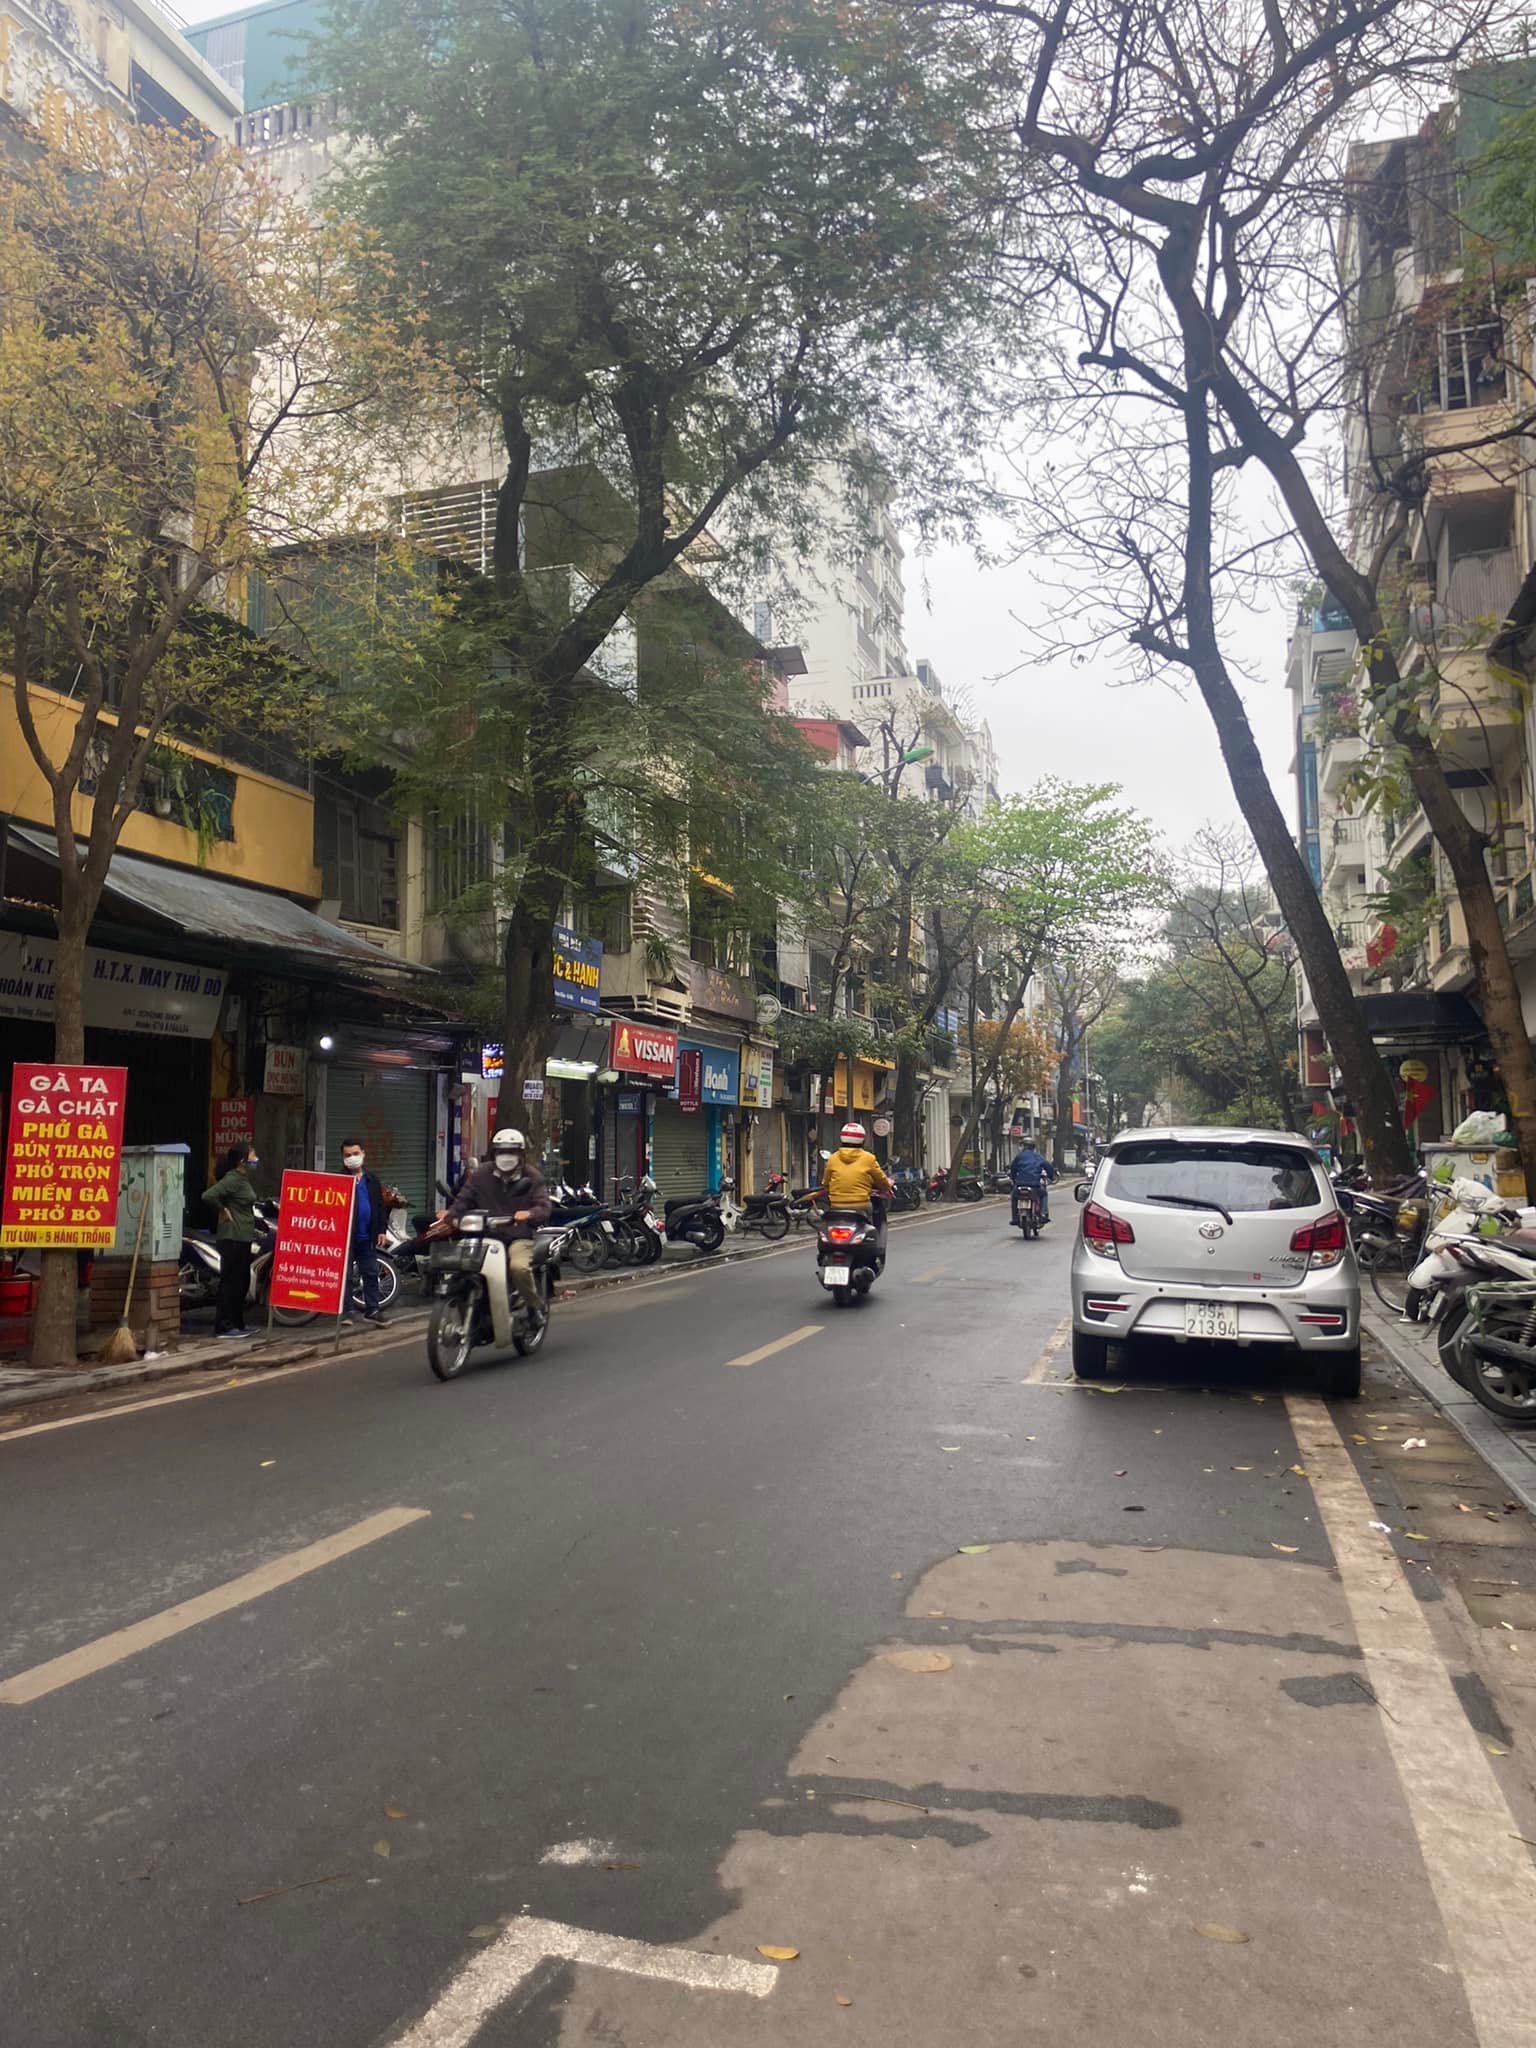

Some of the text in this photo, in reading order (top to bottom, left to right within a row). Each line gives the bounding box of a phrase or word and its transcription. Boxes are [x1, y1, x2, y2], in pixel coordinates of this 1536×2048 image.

[139, 966, 171, 988] MAY
[174, 968, 200, 993] THỦ
[565, 961, 572, 980] &
[633, 1038, 674, 1065] VISSAN
[29, 1072, 109, 1094] GÀ TA
[704, 1064, 728, 1098] Hạnh
[18, 1095, 118, 1120] GÀ CHẶT
[22, 1118, 108, 1140] PHỞ GÀ
[13, 1140, 116, 1160] BÚN THANG
[15, 1159, 111, 1183] PHỞ TRỘN
[12, 1182, 109, 1203] MIẾN GÀ
[287, 1186, 347, 1207] TƯ LÙN
[19, 1203, 101, 1222] PHỞ BÒ
[290, 1215, 336, 1232] PHỞ GÀ
[6, 1229, 18, 1242] TƯ
[19, 1228, 37, 1243] LÙN
[45, 1231, 52, 1242] 5
[54, 1228, 79, 1244] HÀNG
[81, 1226, 111, 1244] TRỐNG
[280, 1240, 342, 1258] BÚN THANG
[1187, 1319, 1236, 1338] 213.94
